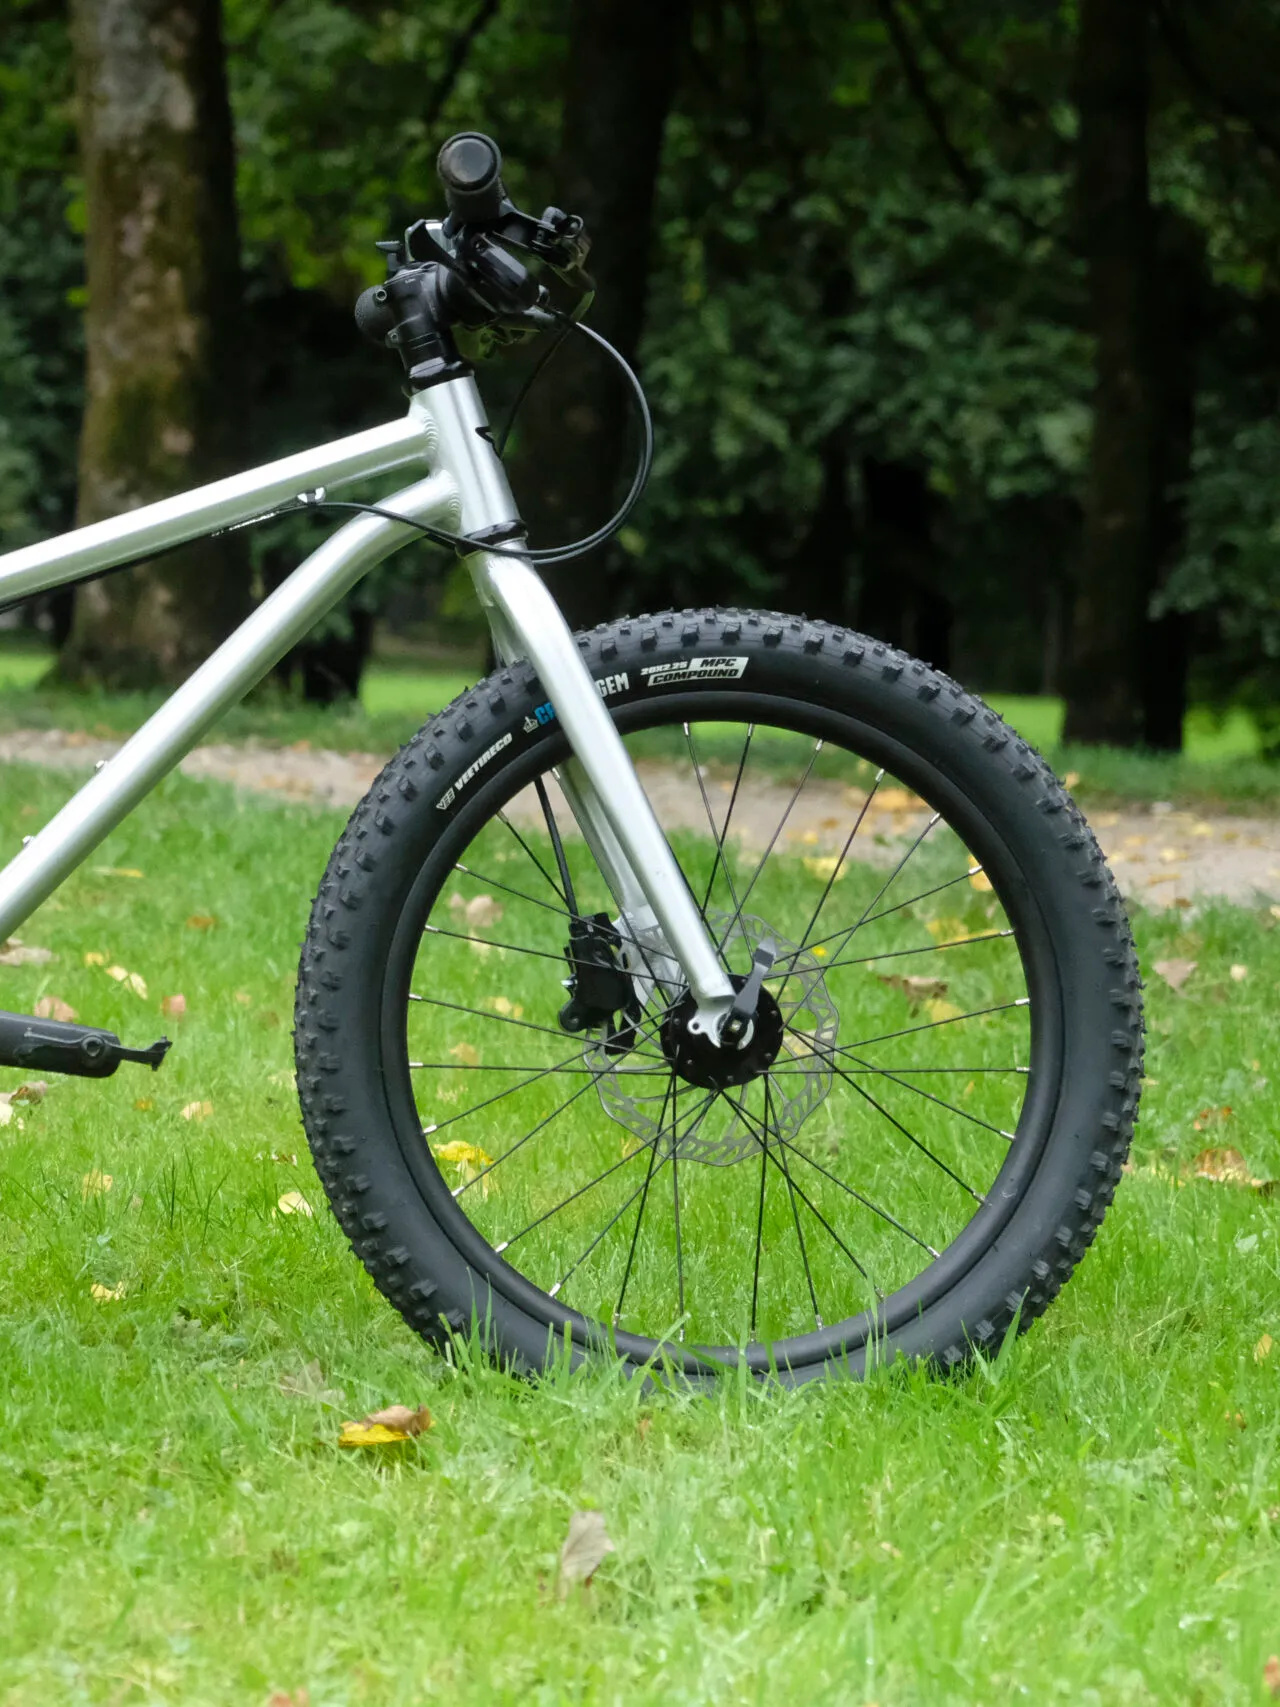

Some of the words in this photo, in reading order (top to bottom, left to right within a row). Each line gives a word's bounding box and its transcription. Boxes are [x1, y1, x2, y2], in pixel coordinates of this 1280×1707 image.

[700, 658, 737, 667] MPC
[595, 672, 630, 698] GEM
[652, 669, 739, 684] COMPOUND
[454, 732, 513, 791] VEETIRECO
